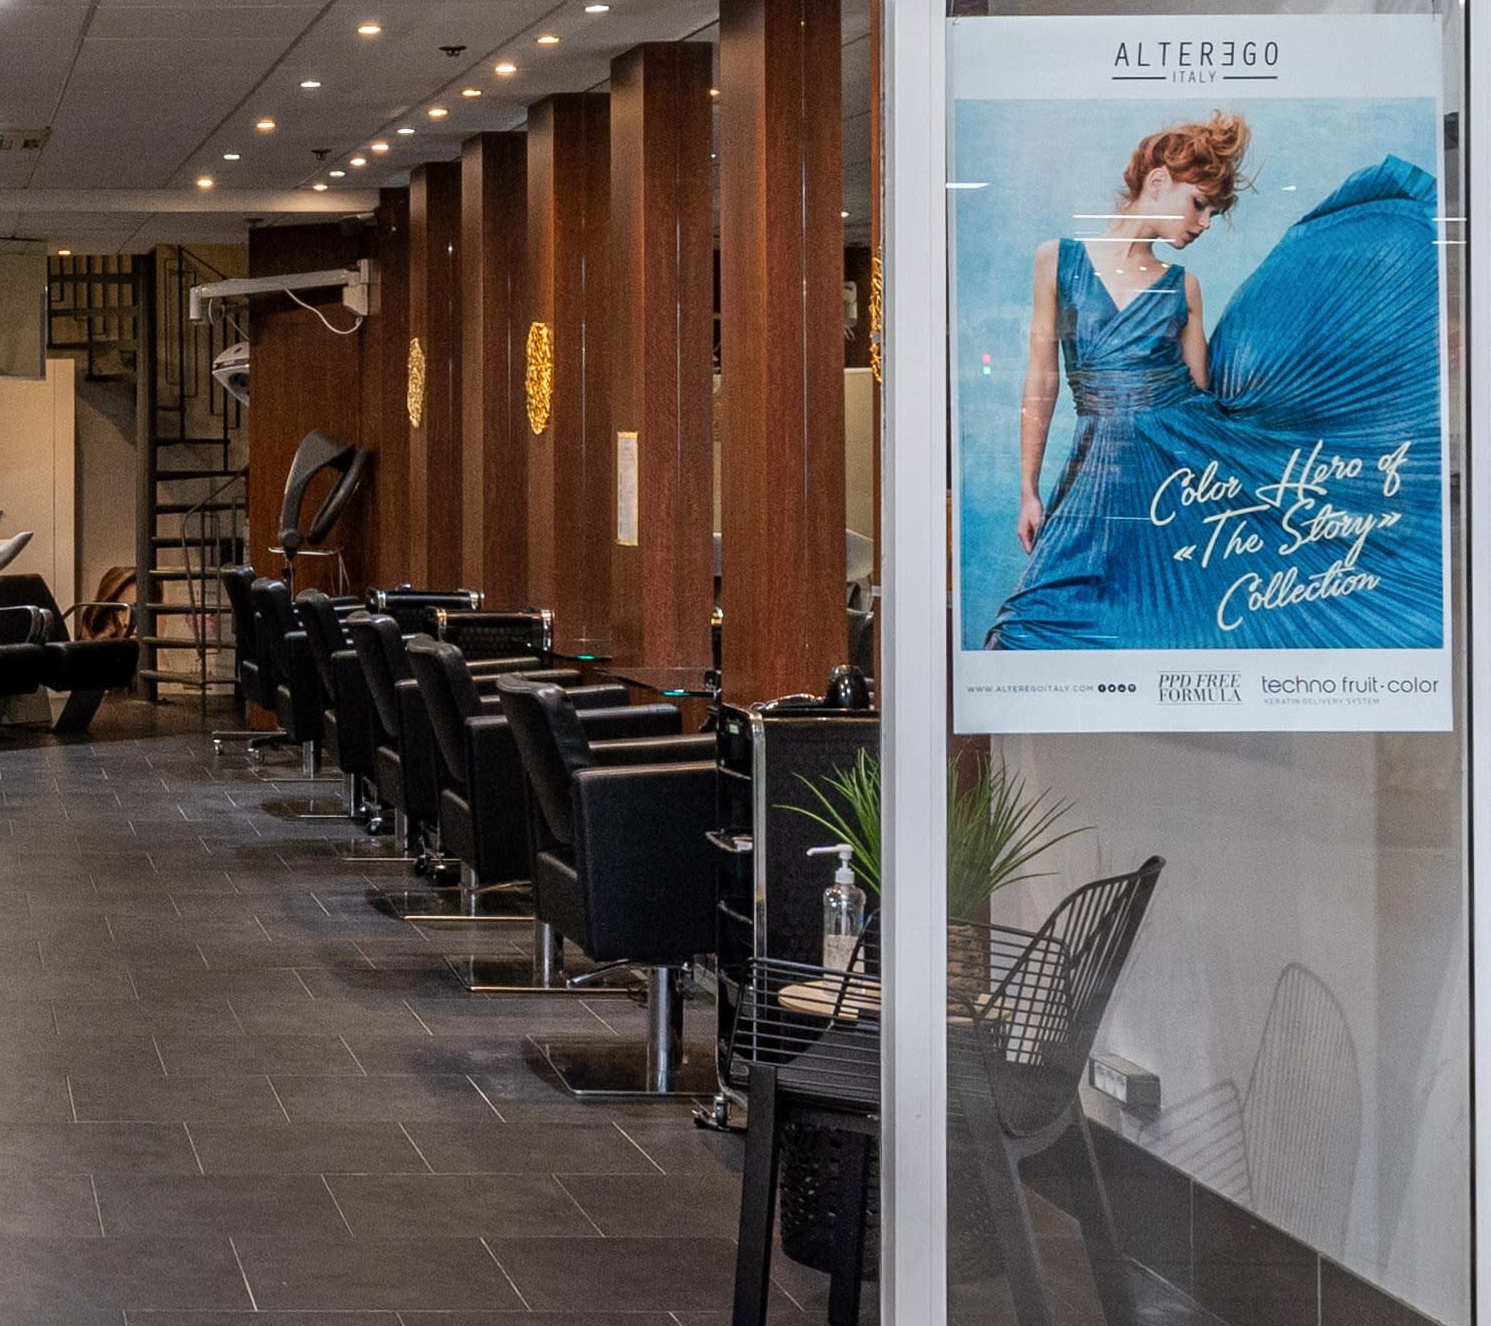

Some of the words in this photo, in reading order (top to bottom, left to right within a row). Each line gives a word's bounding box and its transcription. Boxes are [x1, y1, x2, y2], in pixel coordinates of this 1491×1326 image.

[1172, 71, 1216, 83] ITALY
[1150, 461, 1242, 526] Color
[1256, 439, 1363, 508] Hero
[1378, 441, 1412, 497] of
[1217, 559, 1381, 631] Collection
[1158, 674, 1192, 689] PPD
[1196, 674, 1241, 689] FREE
[1262, 675, 1336, 693] techno
[1159, 688, 1242, 702] FORMULA
[1346, 697, 1380, 705] SYSTEM
